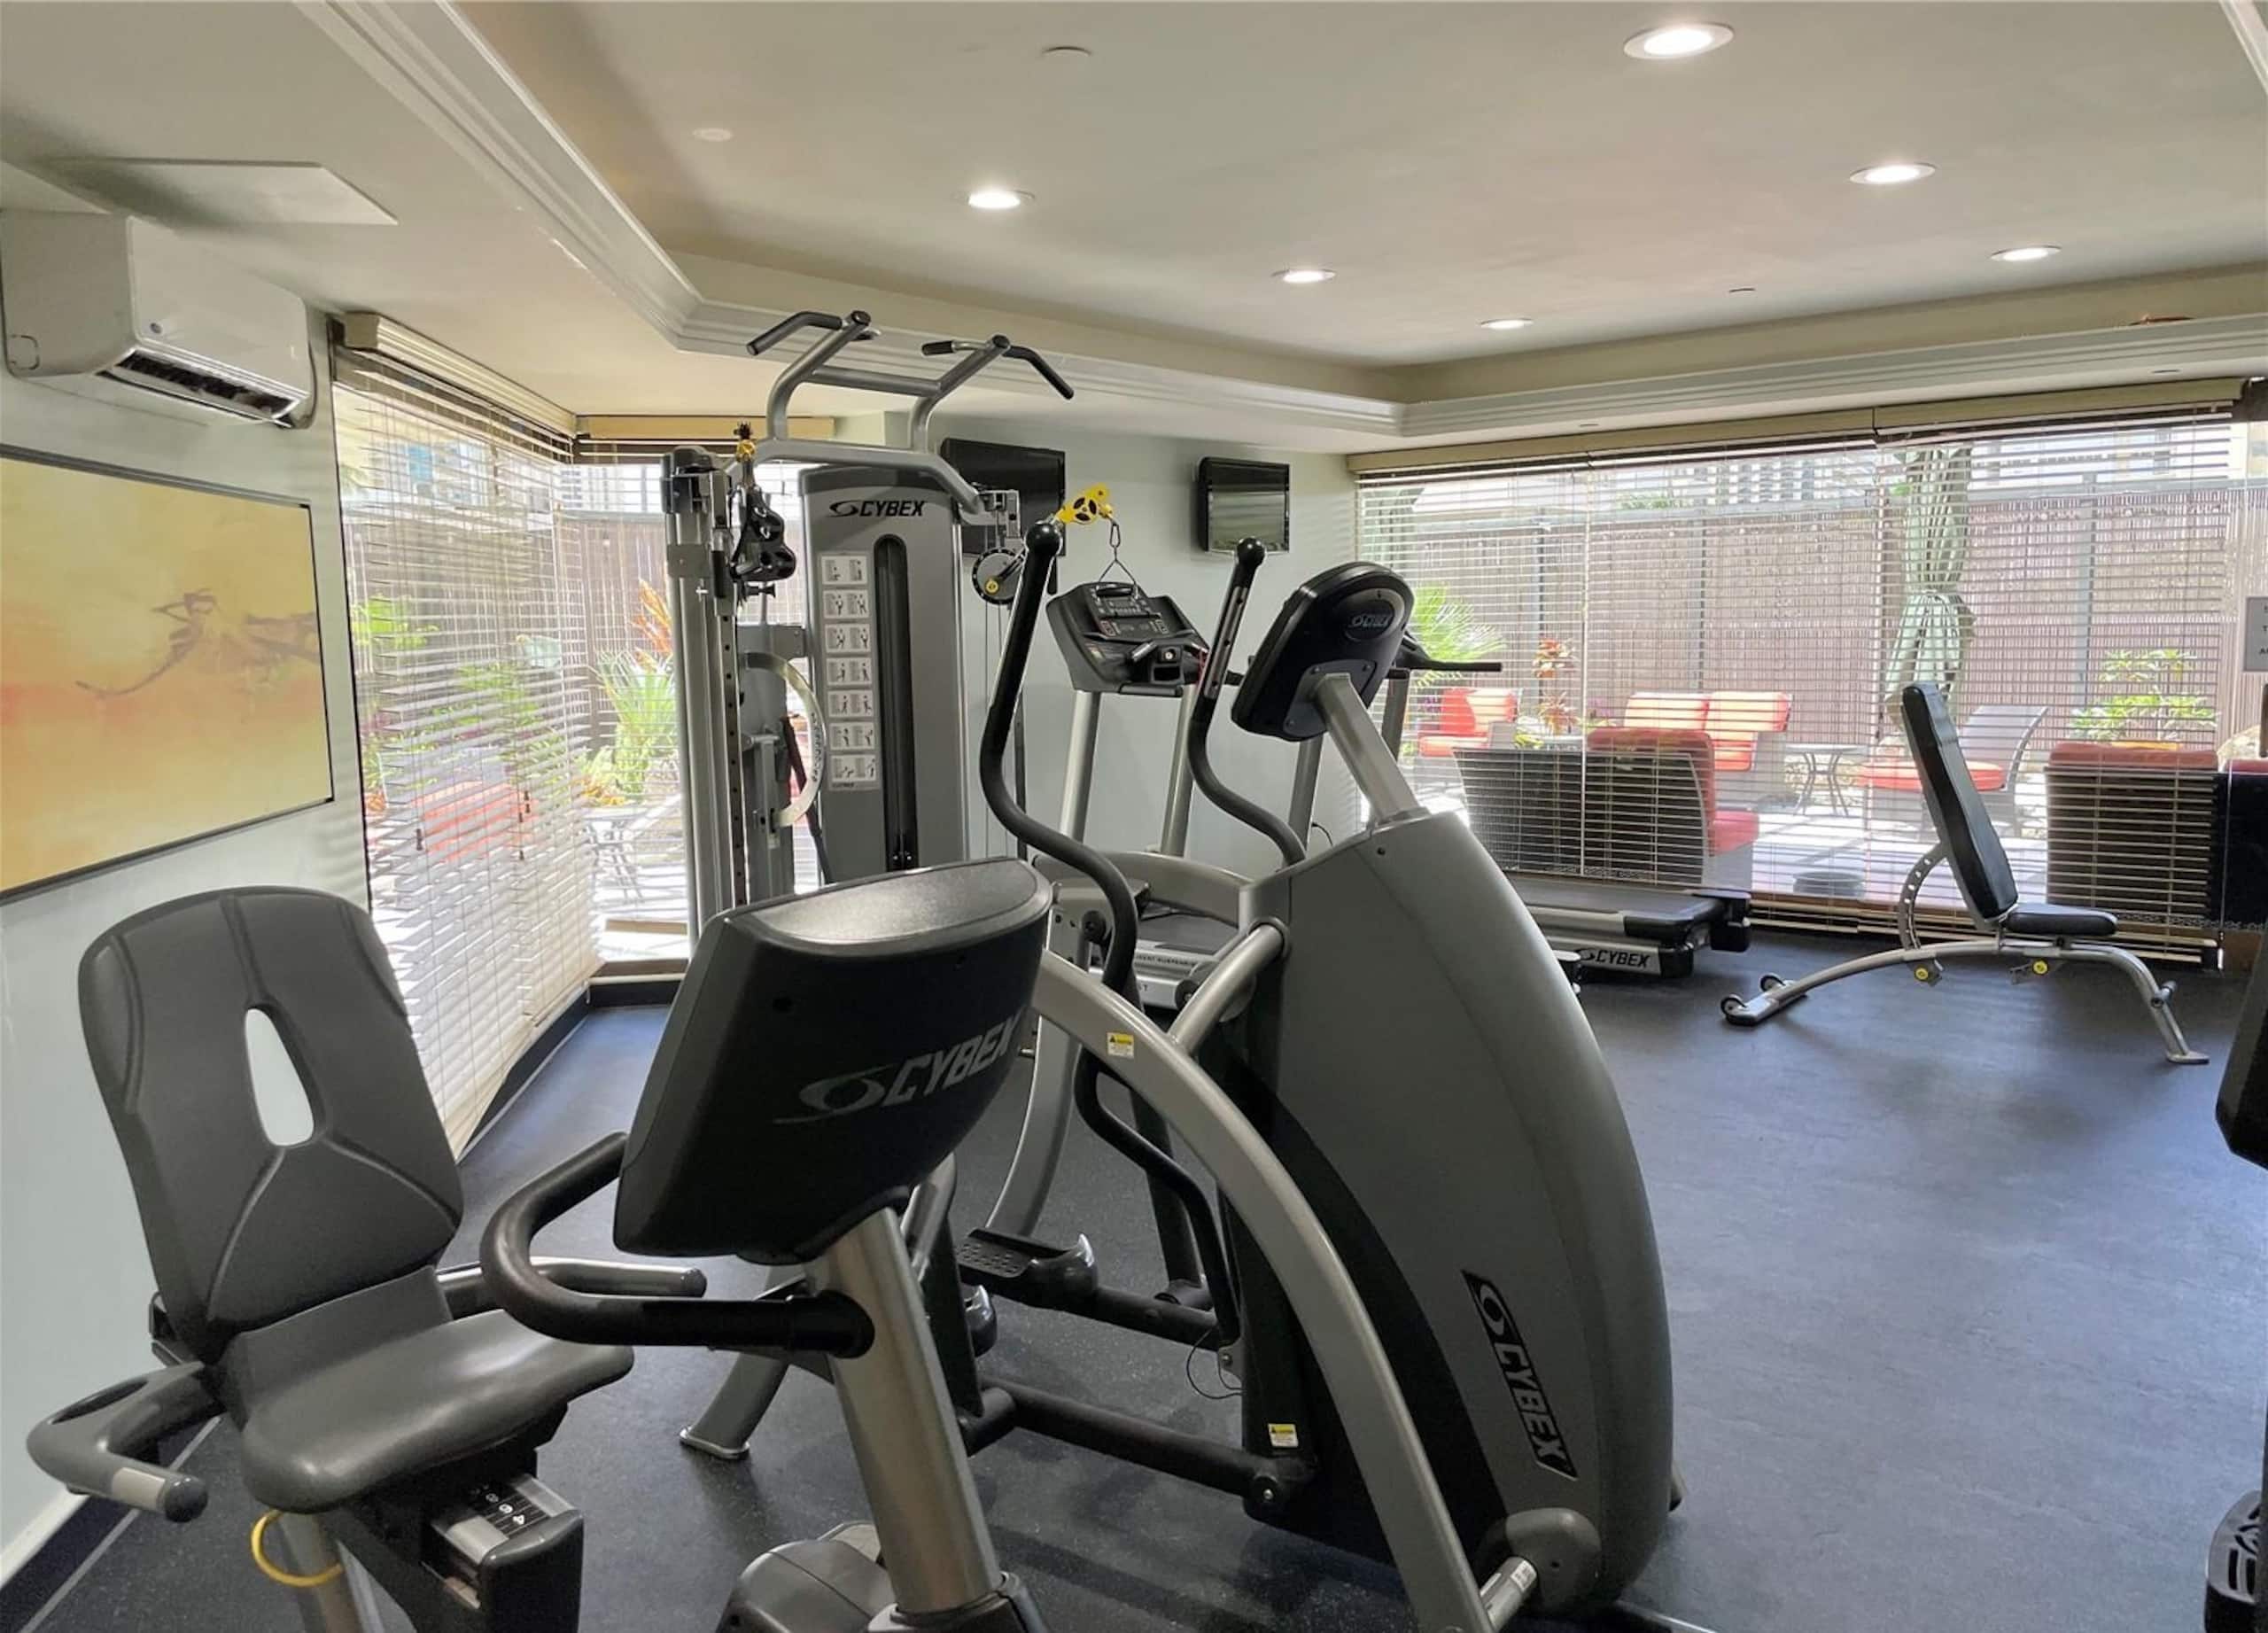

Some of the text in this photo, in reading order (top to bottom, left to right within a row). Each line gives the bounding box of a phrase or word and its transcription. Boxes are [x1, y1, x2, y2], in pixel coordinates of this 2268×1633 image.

[859, 500, 927, 517] CYBEX
[1595, 949, 1650, 968] CYBEX
[881, 1007, 1024, 1108] CYBEX
[1494, 1341, 1568, 1461] CYBEX
